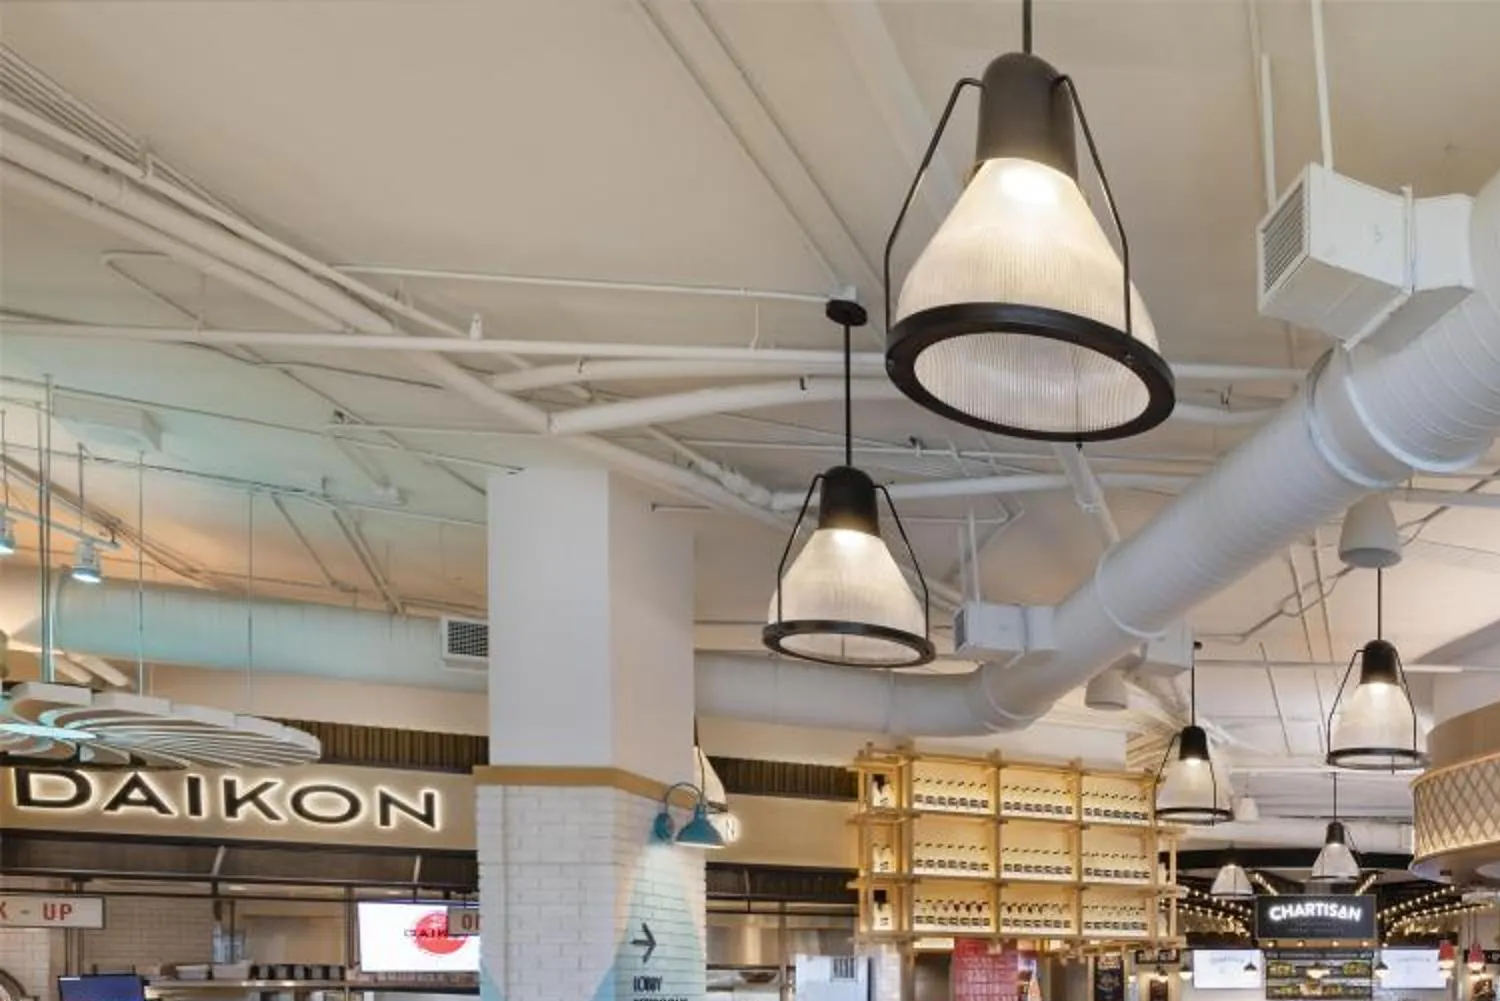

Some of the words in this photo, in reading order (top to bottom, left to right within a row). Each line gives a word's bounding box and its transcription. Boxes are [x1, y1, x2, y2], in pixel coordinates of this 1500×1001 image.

[13, 767, 437, 829] DAIKON
[43, 902, 73, 921] UP
[1267, 901, 1364, 921] CHARTISAN
[633, 975, 662, 992] LOBBY
